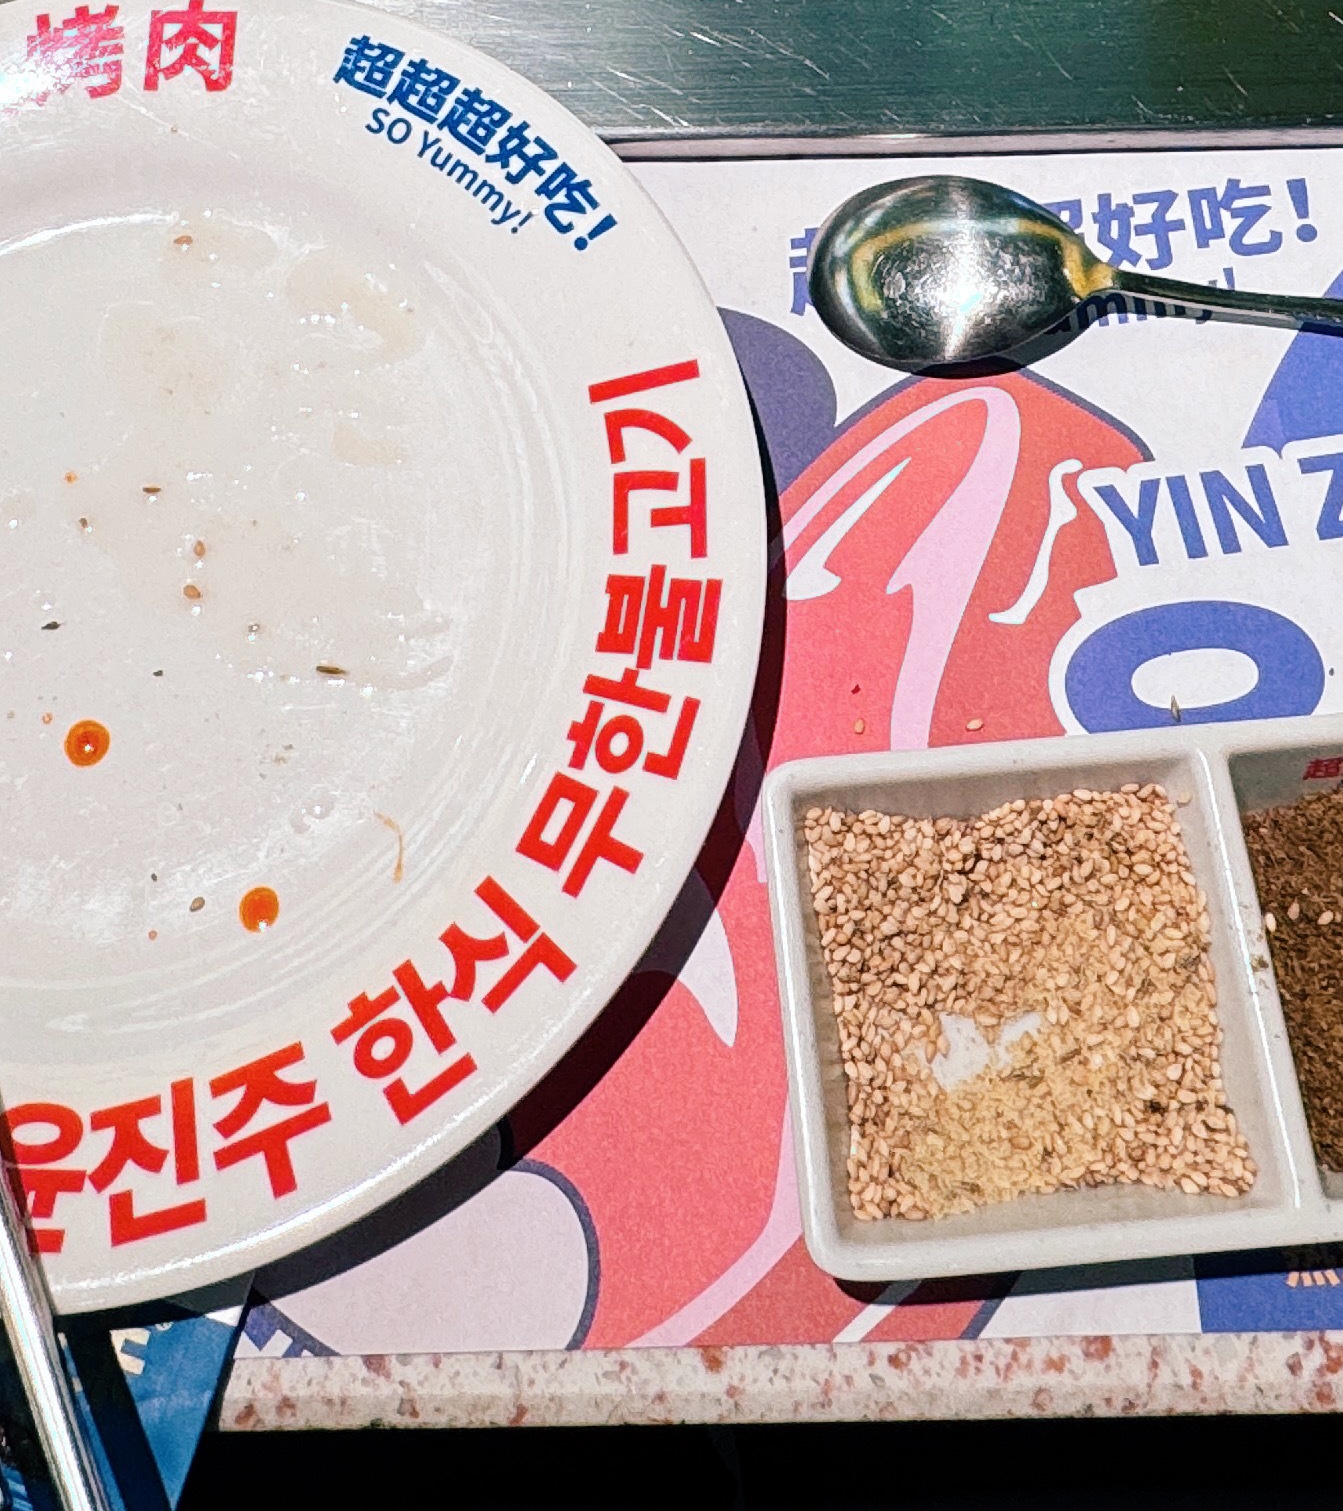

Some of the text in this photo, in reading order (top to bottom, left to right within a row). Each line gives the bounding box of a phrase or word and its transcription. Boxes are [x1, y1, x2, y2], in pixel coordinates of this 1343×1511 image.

[331, 33, 619, 252] 超超超好吃!
[363, 107, 538, 237] SO Yummy!
[1095, 463, 1289, 567] YIN
[515, 358, 724, 899] 무한불고기
[331, 875, 577, 1126] 한식
